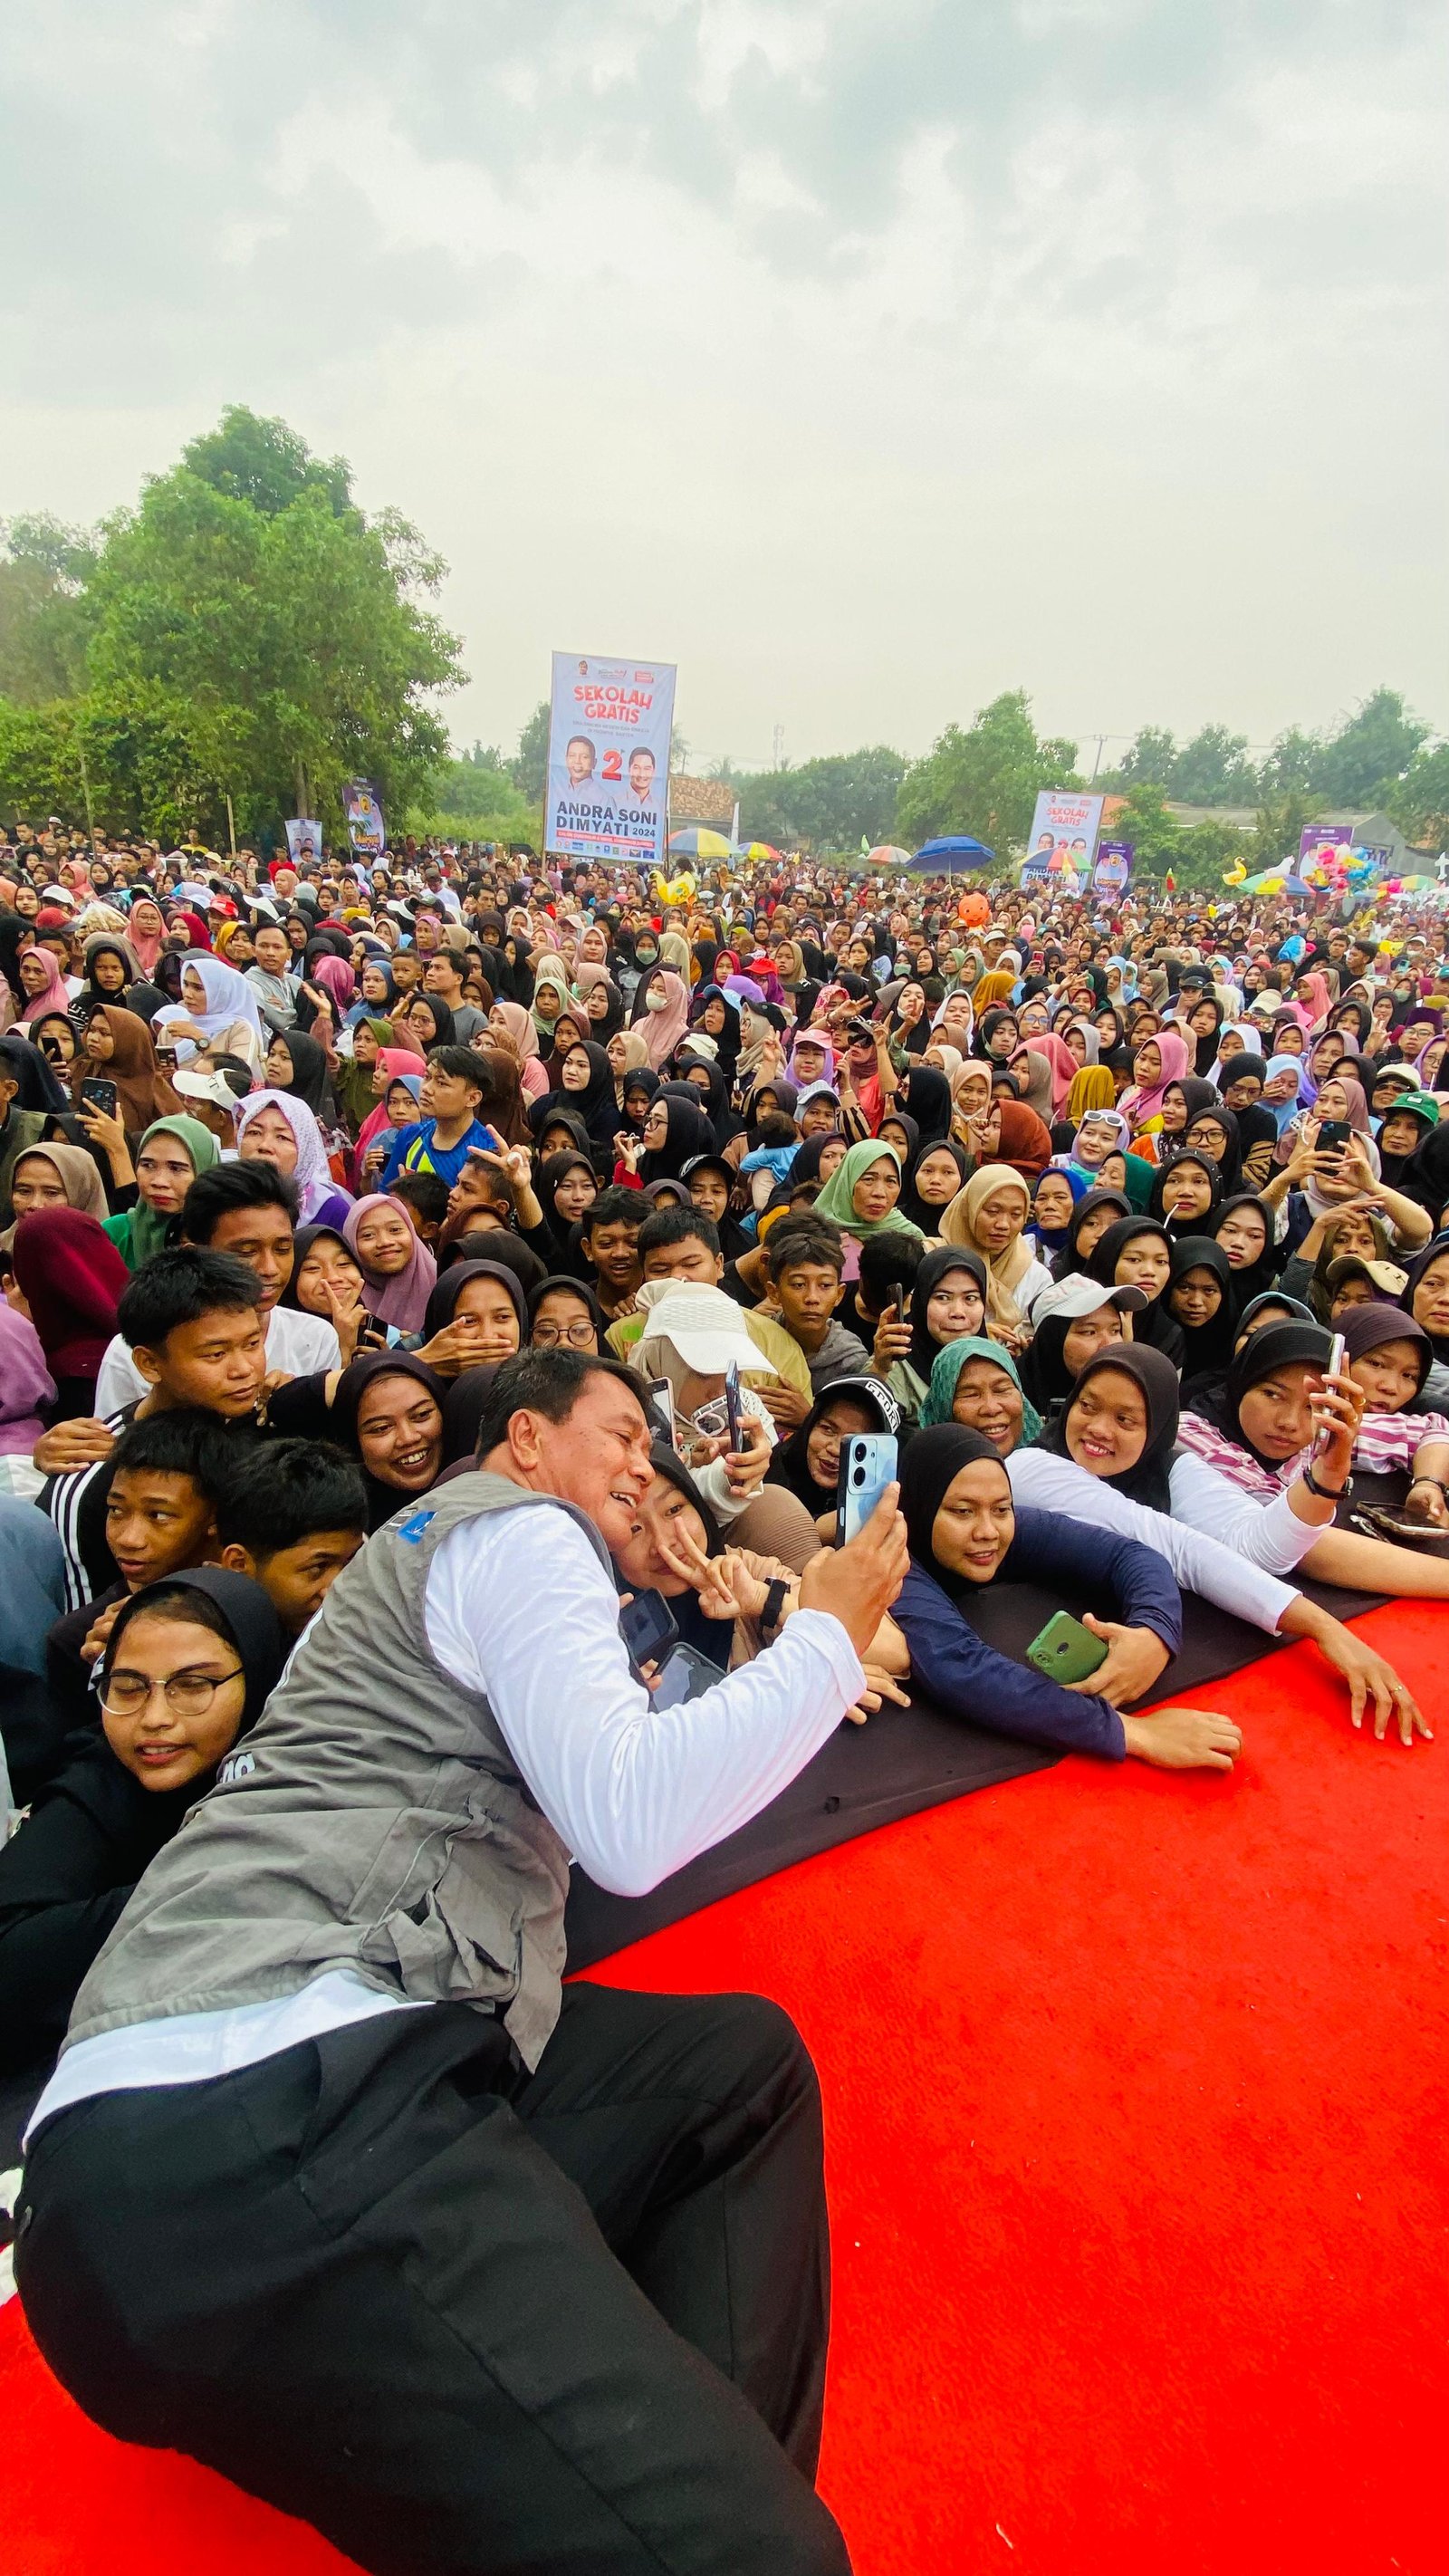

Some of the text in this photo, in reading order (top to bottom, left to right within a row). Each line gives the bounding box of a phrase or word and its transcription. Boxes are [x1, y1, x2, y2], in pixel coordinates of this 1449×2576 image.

[574, 686, 652, 710] SEKOLAH
[584, 702, 640, 725] GRATIS
[602, 749, 623, 781] 2
[557, 801, 657, 826] ANDRA SONI
[1047, 807, 1089, 819] SEKOLAH
[1051, 816, 1080, 826] GRATIS
[556, 815, 657, 838] DIMYATI 2024
